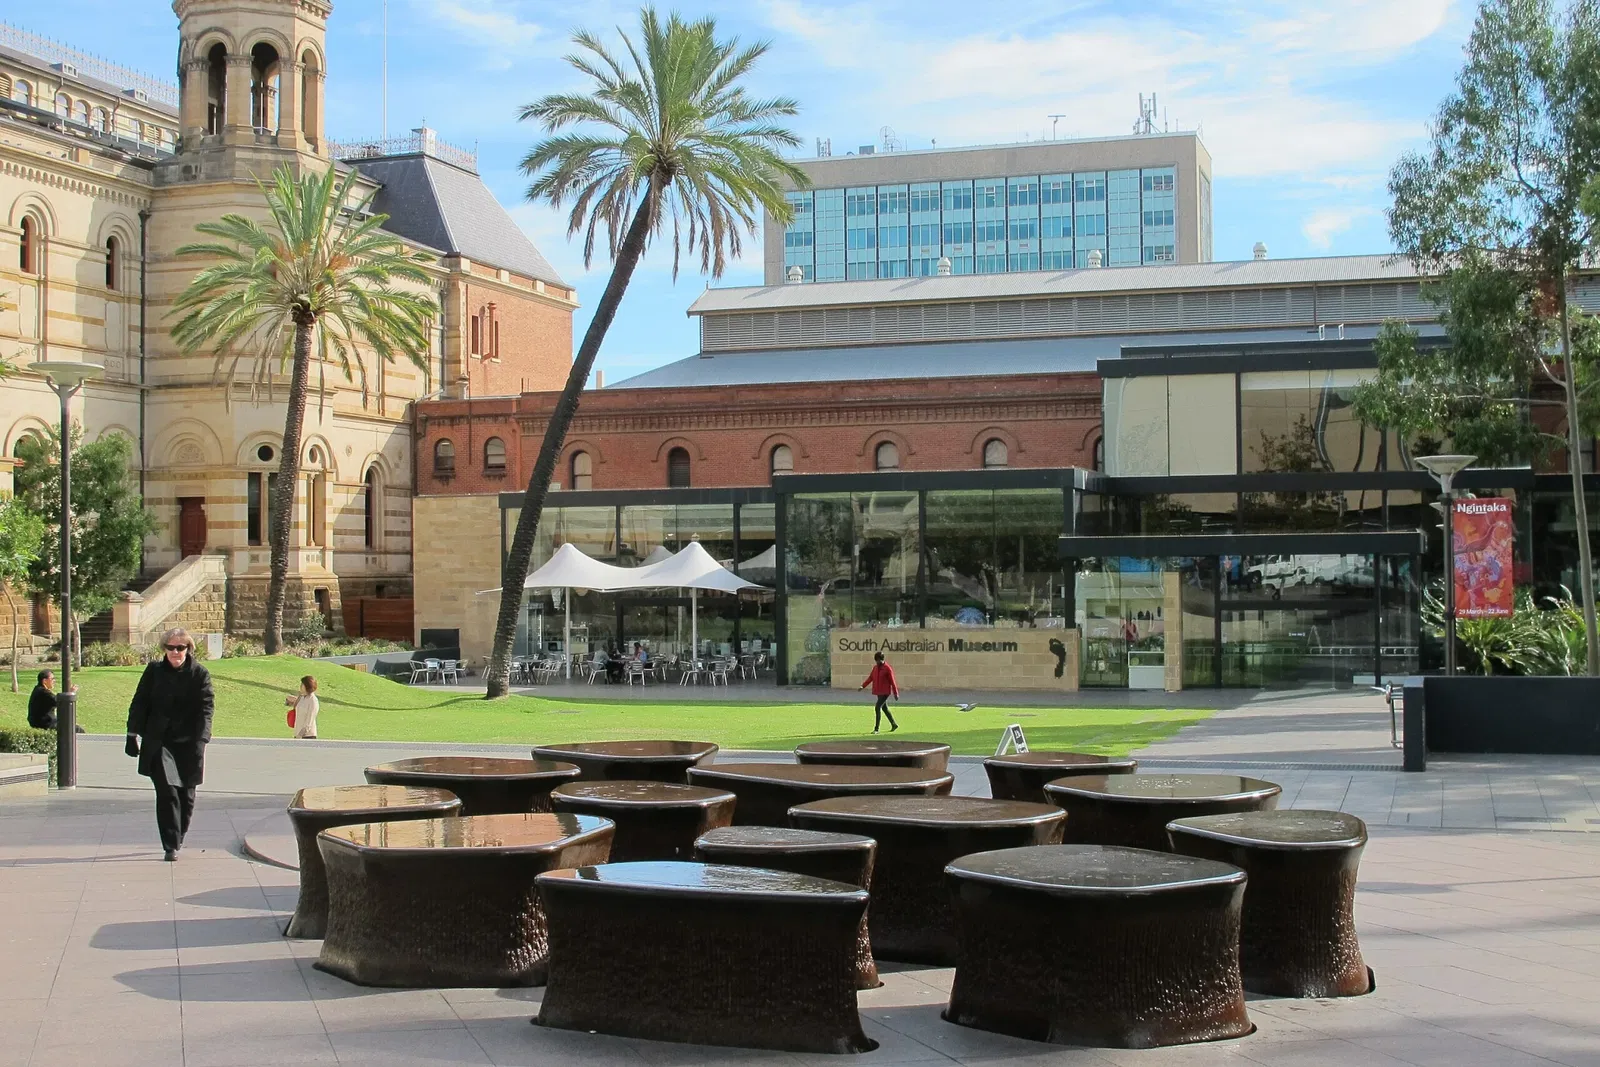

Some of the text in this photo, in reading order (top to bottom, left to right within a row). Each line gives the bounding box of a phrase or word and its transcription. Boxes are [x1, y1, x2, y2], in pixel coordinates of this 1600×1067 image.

[1457, 503, 1507, 514] Ngintaka
[839, 638, 1018, 652] South Australian Museum
